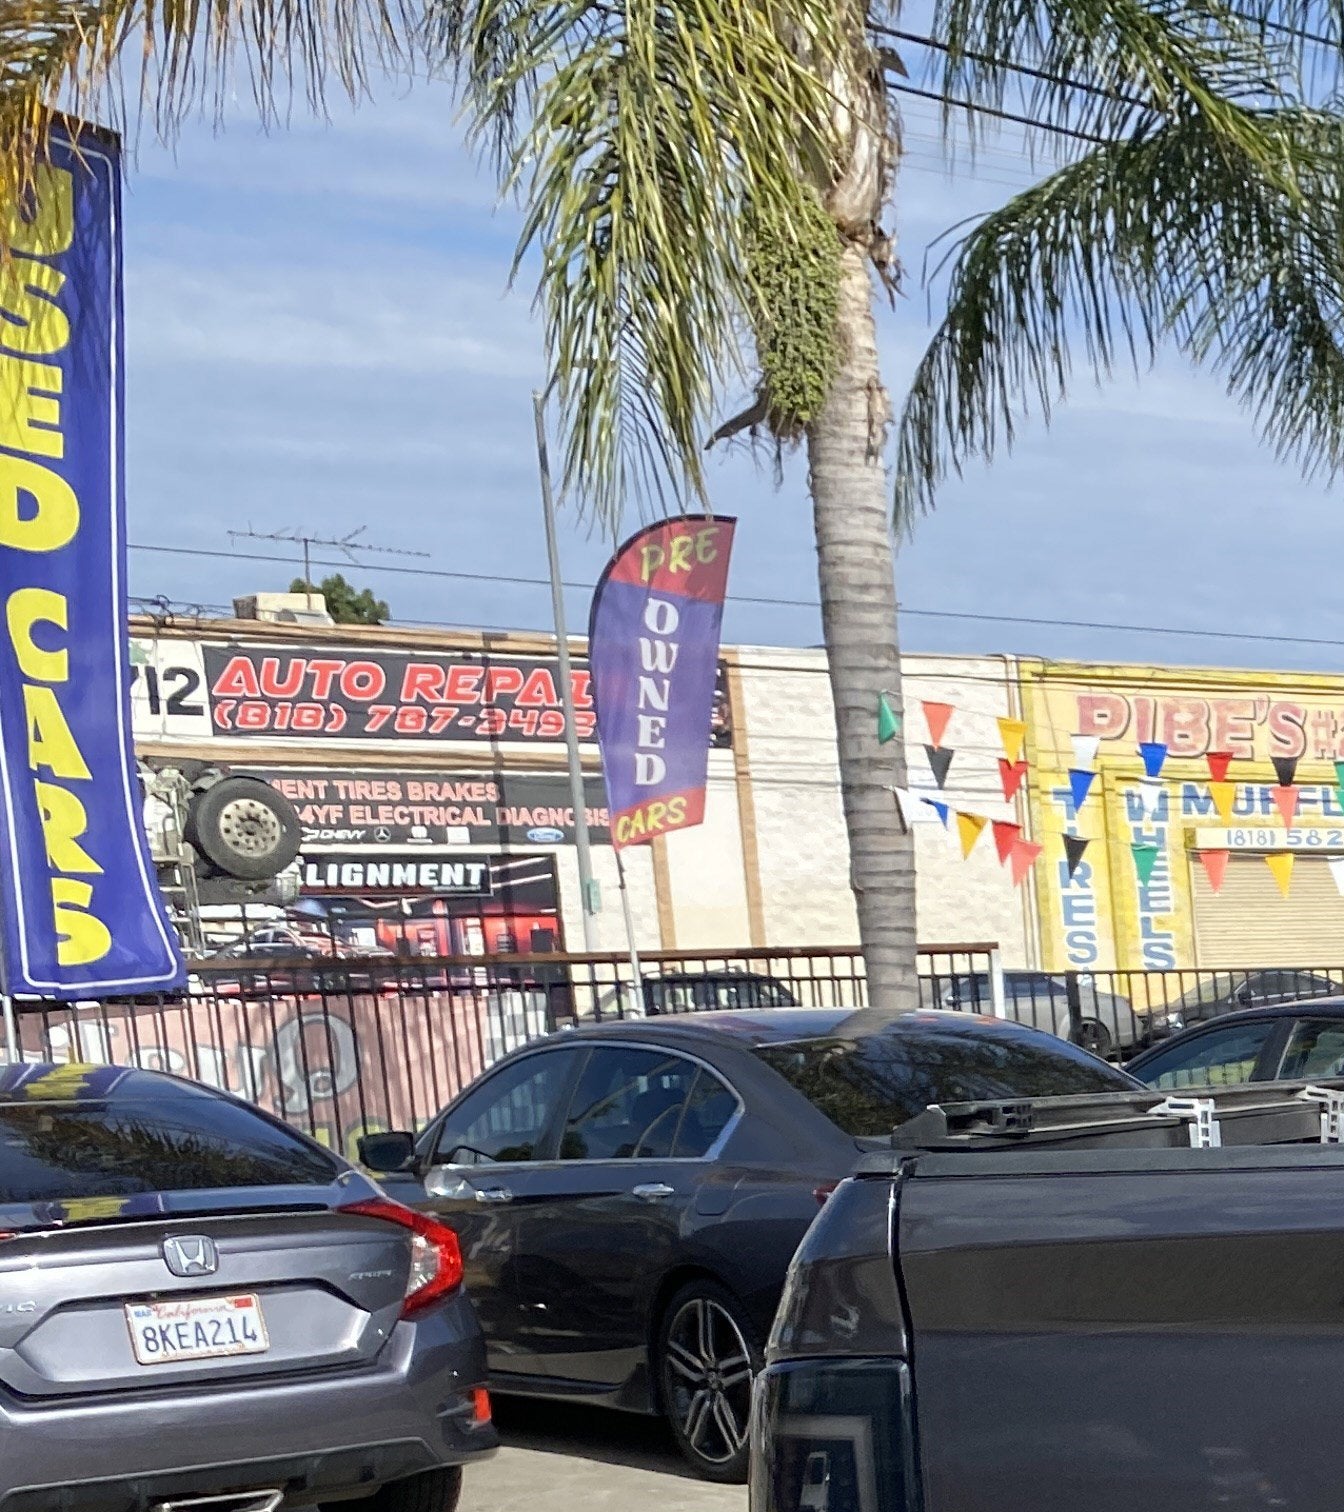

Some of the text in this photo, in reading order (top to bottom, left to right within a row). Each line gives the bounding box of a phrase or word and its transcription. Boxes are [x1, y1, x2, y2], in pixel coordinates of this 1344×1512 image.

[131, 666, 204, 716] 12
[212, 656, 594, 708] AUTO REPAI
[616, 527, 720, 843] PRE OWNED CARS
[213, 699, 347, 731] (818)
[6, 588, 112, 966] CARS
[332, 781, 402, 800] TIRES
[407, 781, 499, 802] BRAKES
[349, 805, 491, 826] ELECTRICAL
[1227, 829, 1276, 846] (818)
[142, 1316, 258, 1353] 8KEA214
